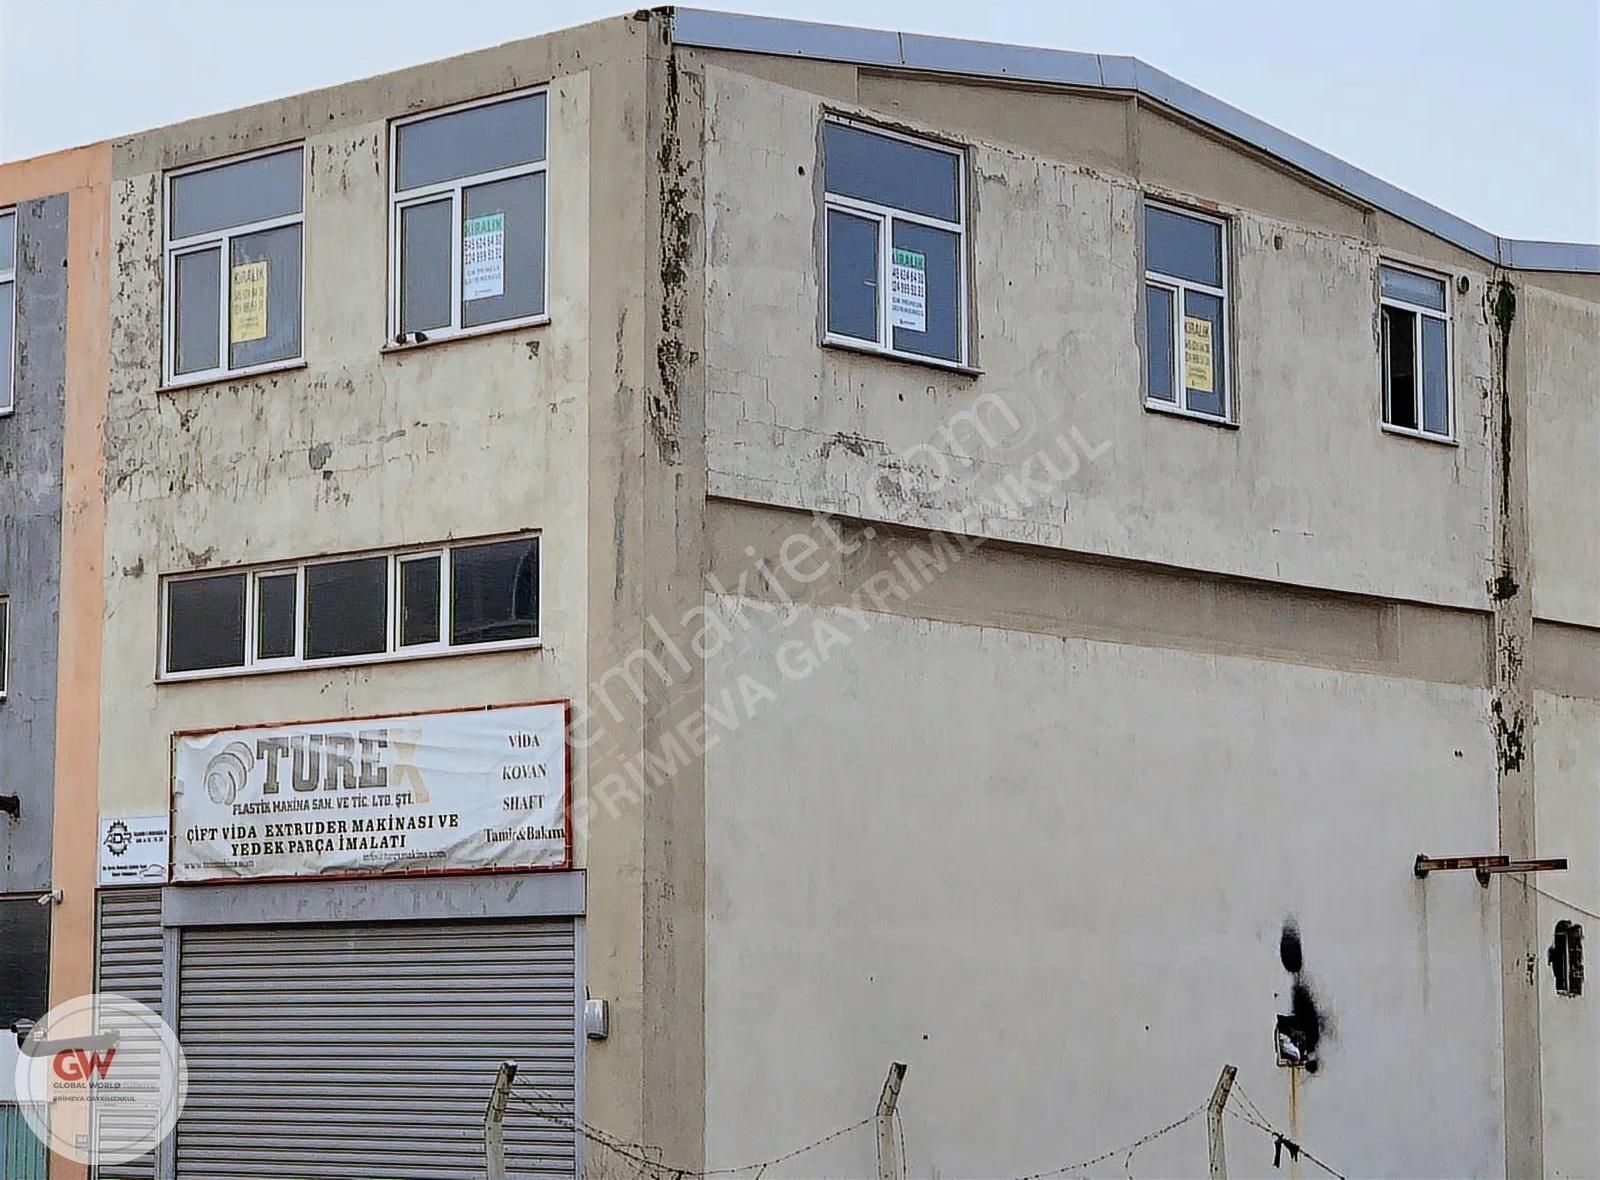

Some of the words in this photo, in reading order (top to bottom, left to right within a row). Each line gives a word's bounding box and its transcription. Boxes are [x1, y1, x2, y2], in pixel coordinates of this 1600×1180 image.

[256, 727, 429, 803] TUREX
[502, 763, 547, 781] KOVAN
[502, 794, 545, 811] SHAFT
[186, 824, 218, 845] ÇİFT
[222, 823, 257, 840] VİDA
[265, 819, 347, 839] EXTRUDER
[351, 813, 434, 833] MAKİNASI
[438, 813, 459, 828] VE
[231, 840, 286, 856] YEDEK
[288, 837, 335, 855] PARÇA
[338, 834, 407, 851] İMALATI
